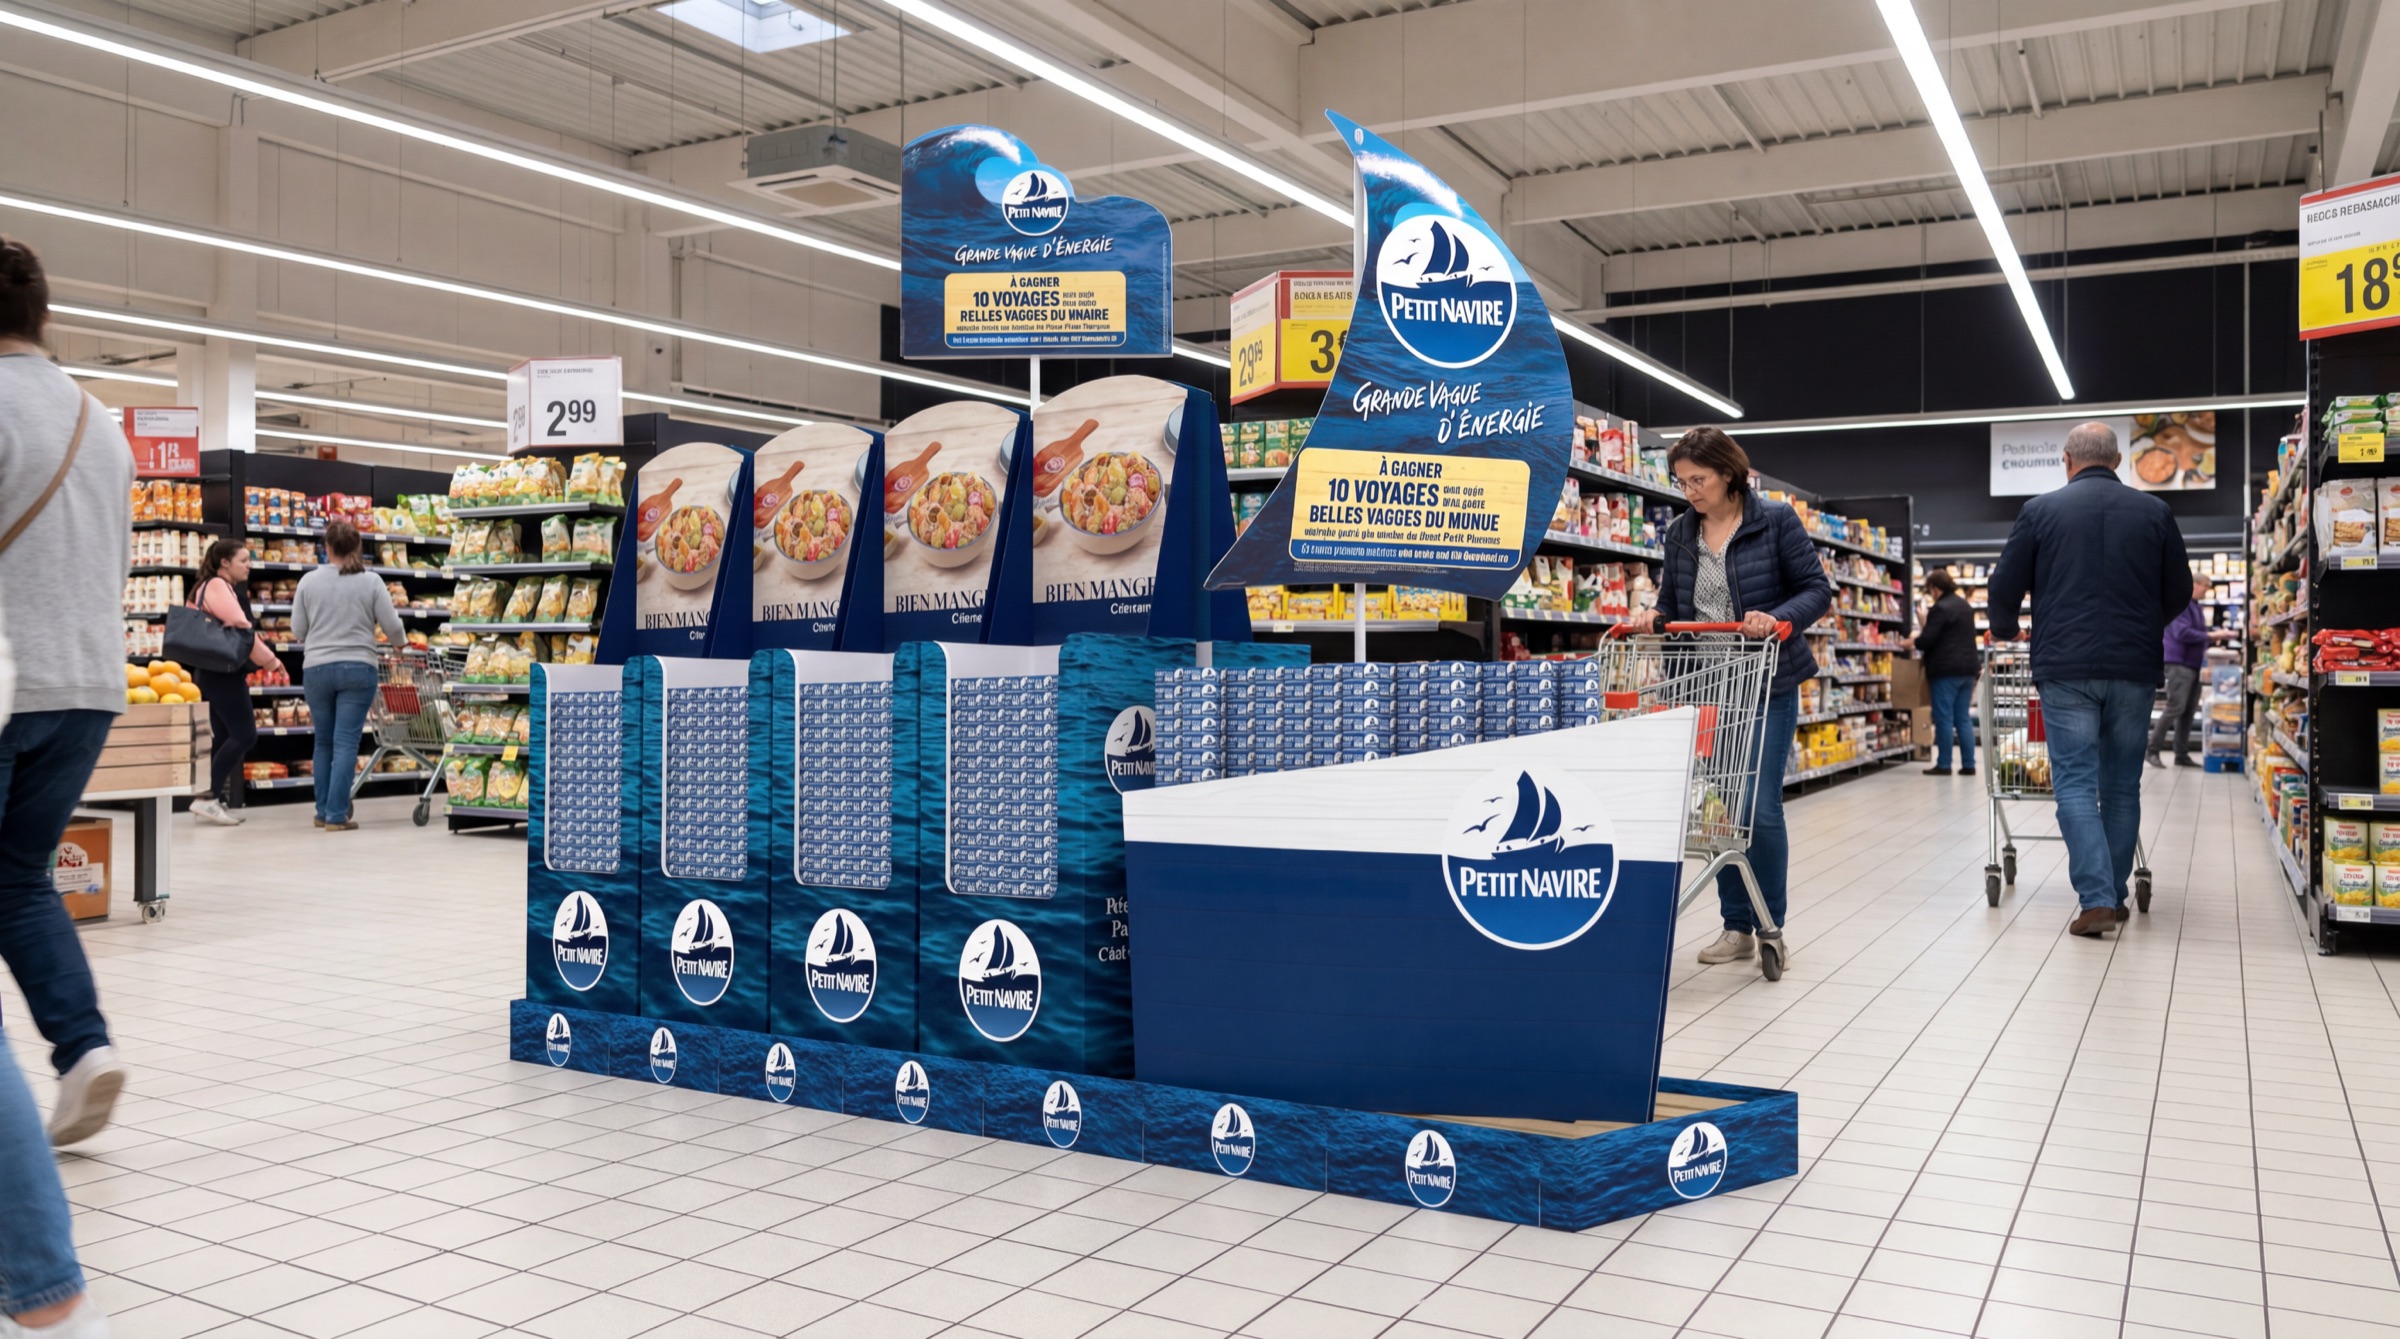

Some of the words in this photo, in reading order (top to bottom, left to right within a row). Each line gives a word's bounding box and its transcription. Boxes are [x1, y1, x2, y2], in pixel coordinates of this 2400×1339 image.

[955, 244, 1001, 266] GRANDE
[1004, 244, 1039, 263] VAGUE
[1010, 275, 1017, 288] À
[1019, 277, 1060, 288] GAGNER
[973, 291, 990, 307] 10
[992, 290, 1060, 307] VOYAGES
[1391, 292, 1438, 322] PETIT
[1440, 297, 1504, 326] NAVIRE
[1004, 309, 1048, 321] VAGGES
[1050, 309, 1066, 321] DU
[1353, 381, 1426, 422] GRANDE
[1429, 380, 1482, 412] VAGUE
[1379, 455, 1388, 476] À
[1391, 460, 1443, 479] GAGNER
[1328, 478, 1350, 502] 10
[1354, 479, 1440, 507] VOYAGES
[1309, 504, 1363, 525] BELLES
[1367, 507, 1422, 527] VAGGES
[1425, 510, 1445, 529] DU
[1448, 511, 1500, 532] MUNUE
[896, 593, 930, 612] BIEN
[934, 589, 987, 610] MANG
[1046, 581, 1085, 602] BIEN
[645, 612, 673, 629] BIEN
[763, 603, 793, 621] BIEN
[1460, 866, 1518, 897] PETIT
[1521, 867, 1601, 899] NAVIRE
[698, 958, 728, 979] NAVIRE
[811, 968, 835, 989] PETIT
[836, 971, 870, 994] NAVIRE
[966, 984, 994, 1006] PETIT
[994, 987, 1033, 1011] NAVIRE
